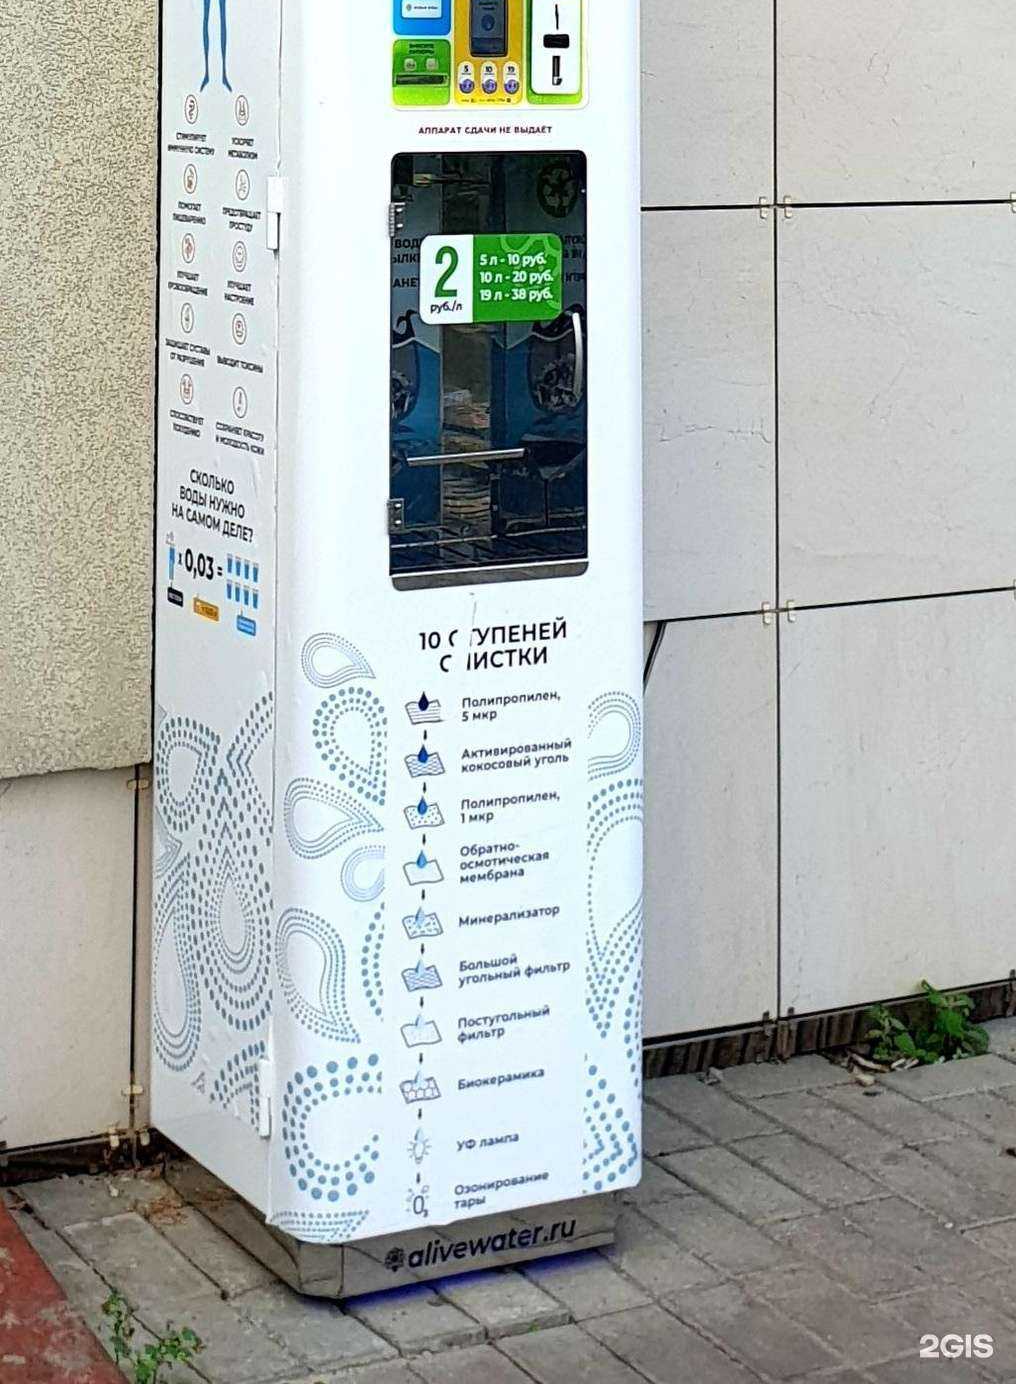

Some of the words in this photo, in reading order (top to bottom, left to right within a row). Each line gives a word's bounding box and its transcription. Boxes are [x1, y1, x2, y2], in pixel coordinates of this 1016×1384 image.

[485, 65, 493, 73] 10
[418, 126, 462, 135] АППАРАТ
[464, 126, 497, 135] СДАЧИ
[499, 126, 512, 134] НЕ
[434, 245, 459, 298] 2
[480, 254, 488, 266] 5
[490, 256, 498, 266] л
[508, 254, 520, 266] 10
[522, 253, 548, 269] руб.
[480, 272, 492, 284] 10
[494, 274, 503, 284] л
[512, 271, 527, 283] 20
[529, 271, 554, 286] руб.
[480, 290, 492, 302] 19
[494, 291, 503, 302] л
[512, 288, 527, 301] 38
[528, 288, 554, 304] руб.
[430, 300, 462, 314] руб./л
[190, 468, 235, 496] СКОЛЬКО
[180, 485, 208, 508] ВОДЫ
[209, 496, 246, 520] НУЖНО
[171, 502, 184, 520] НА
[186, 508, 221, 533] САМОМ
[222, 520, 254, 543] ДЕЛЕ?
[185, 548, 214, 580] 0,03
[419, 631, 441, 650] 10
[448, 616, 567, 648] СУПЕНЕЙ
[462, 690, 561, 709] Полипропилен,
[462, 711, 469, 722] 5
[472, 709, 498, 723] мкр
[461, 738, 572, 760] Активированный
[461, 754, 531, 774] кокосовый
[534, 753, 570, 769] уголь
[461, 790, 560, 810] Полипропилен,
[461, 812, 466, 824] 1
[468, 811, 494, 825] мкр
[460, 842, 520, 860] Обратно-
[460, 850, 550, 871] осмотическая
[460, 866, 525, 885] мембрана
[458, 904, 560, 928] Минерализатор
[458, 952, 518, 972] Большой
[458, 965, 521, 988] угольный
[524, 960, 571, 977] фильтр
[458, 1004, 550, 1030] Постугольный
[458, 1026, 505, 1045] фильтр
[458, 1067, 545, 1091] Биокерамика
[456, 1136, 476, 1152] УФ
[479, 1131, 520, 1148] лампа
[454, 1170, 550, 1196] Озонирование
[454, 1196, 486, 1210] тары
[408, 1220, 576, 1268] alivewater.ru
